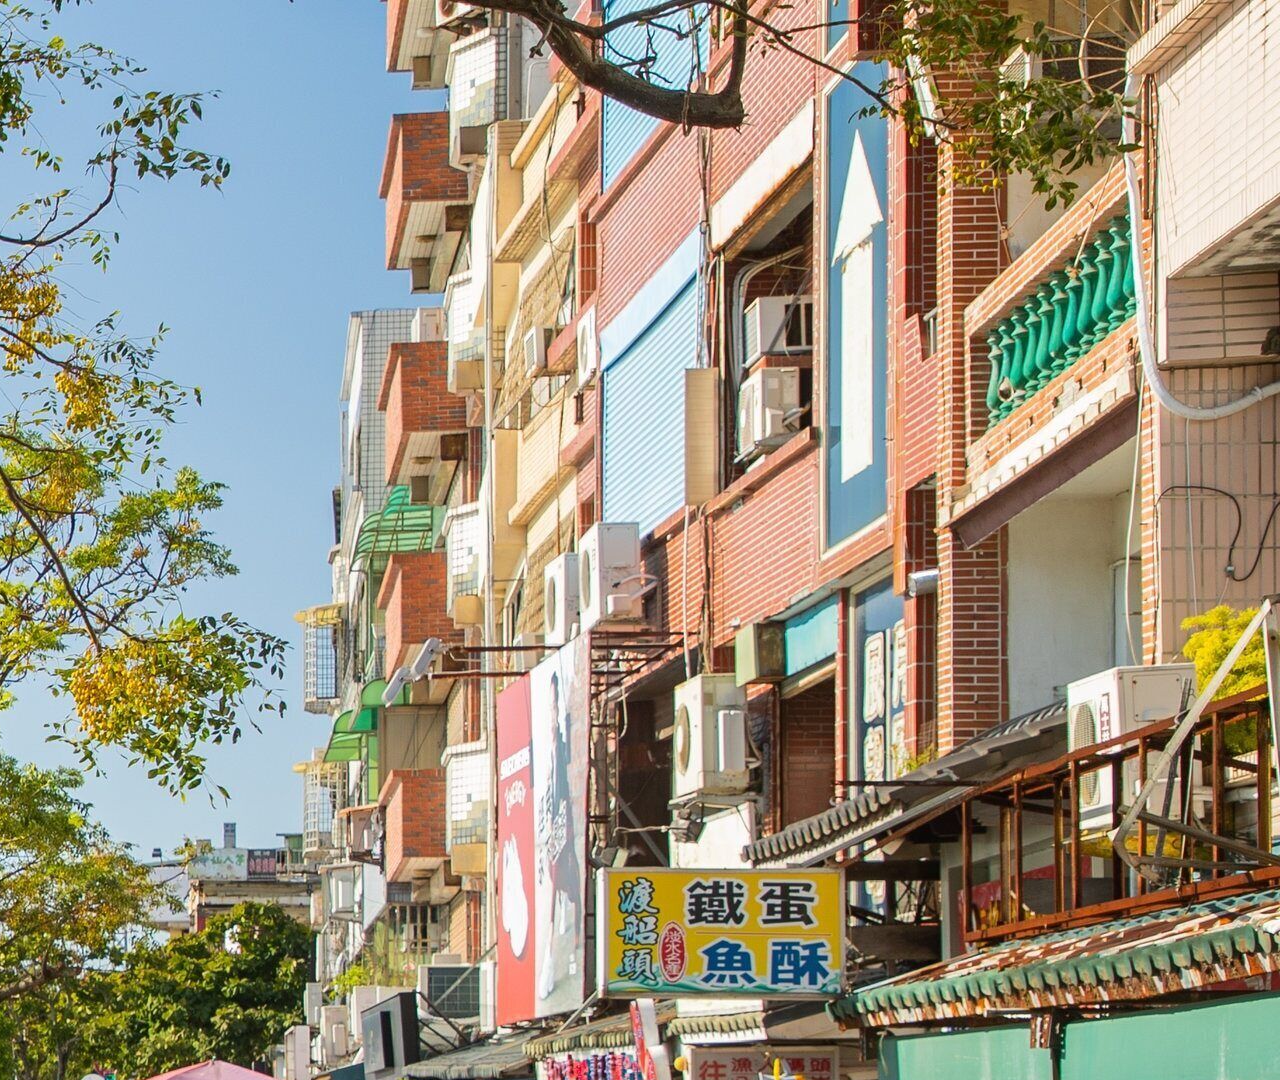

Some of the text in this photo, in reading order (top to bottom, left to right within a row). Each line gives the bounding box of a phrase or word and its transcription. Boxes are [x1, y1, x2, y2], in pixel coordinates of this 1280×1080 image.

[687, 880, 815, 926] 鐵蛋
[617, 877, 659, 981] 渡船頭
[700, 940, 829, 986] 魚酥
